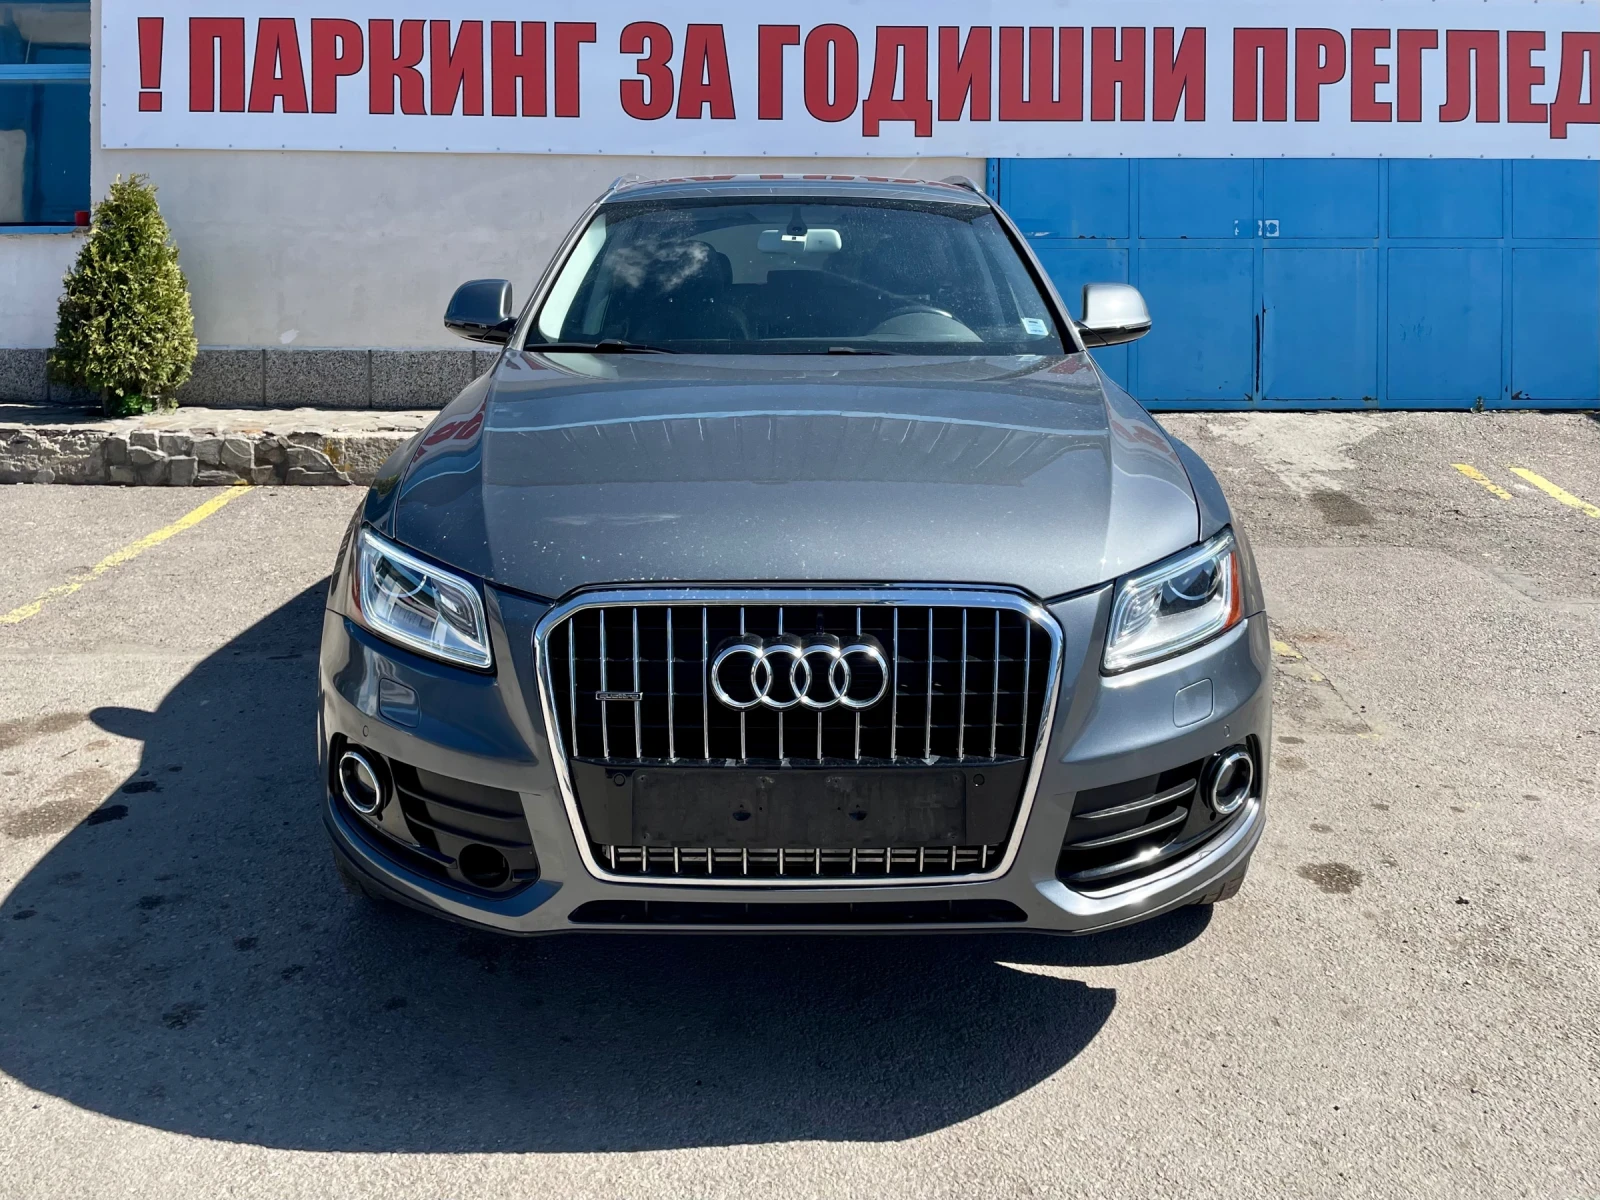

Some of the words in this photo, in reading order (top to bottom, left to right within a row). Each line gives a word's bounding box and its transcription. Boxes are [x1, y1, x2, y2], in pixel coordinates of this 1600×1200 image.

[138, 17, 163, 111] !
[189, 17, 597, 117] ПАРКИНГ
[620, 22, 735, 120] ЗА
[758, 24, 1206, 136] ГОДИШНИ
